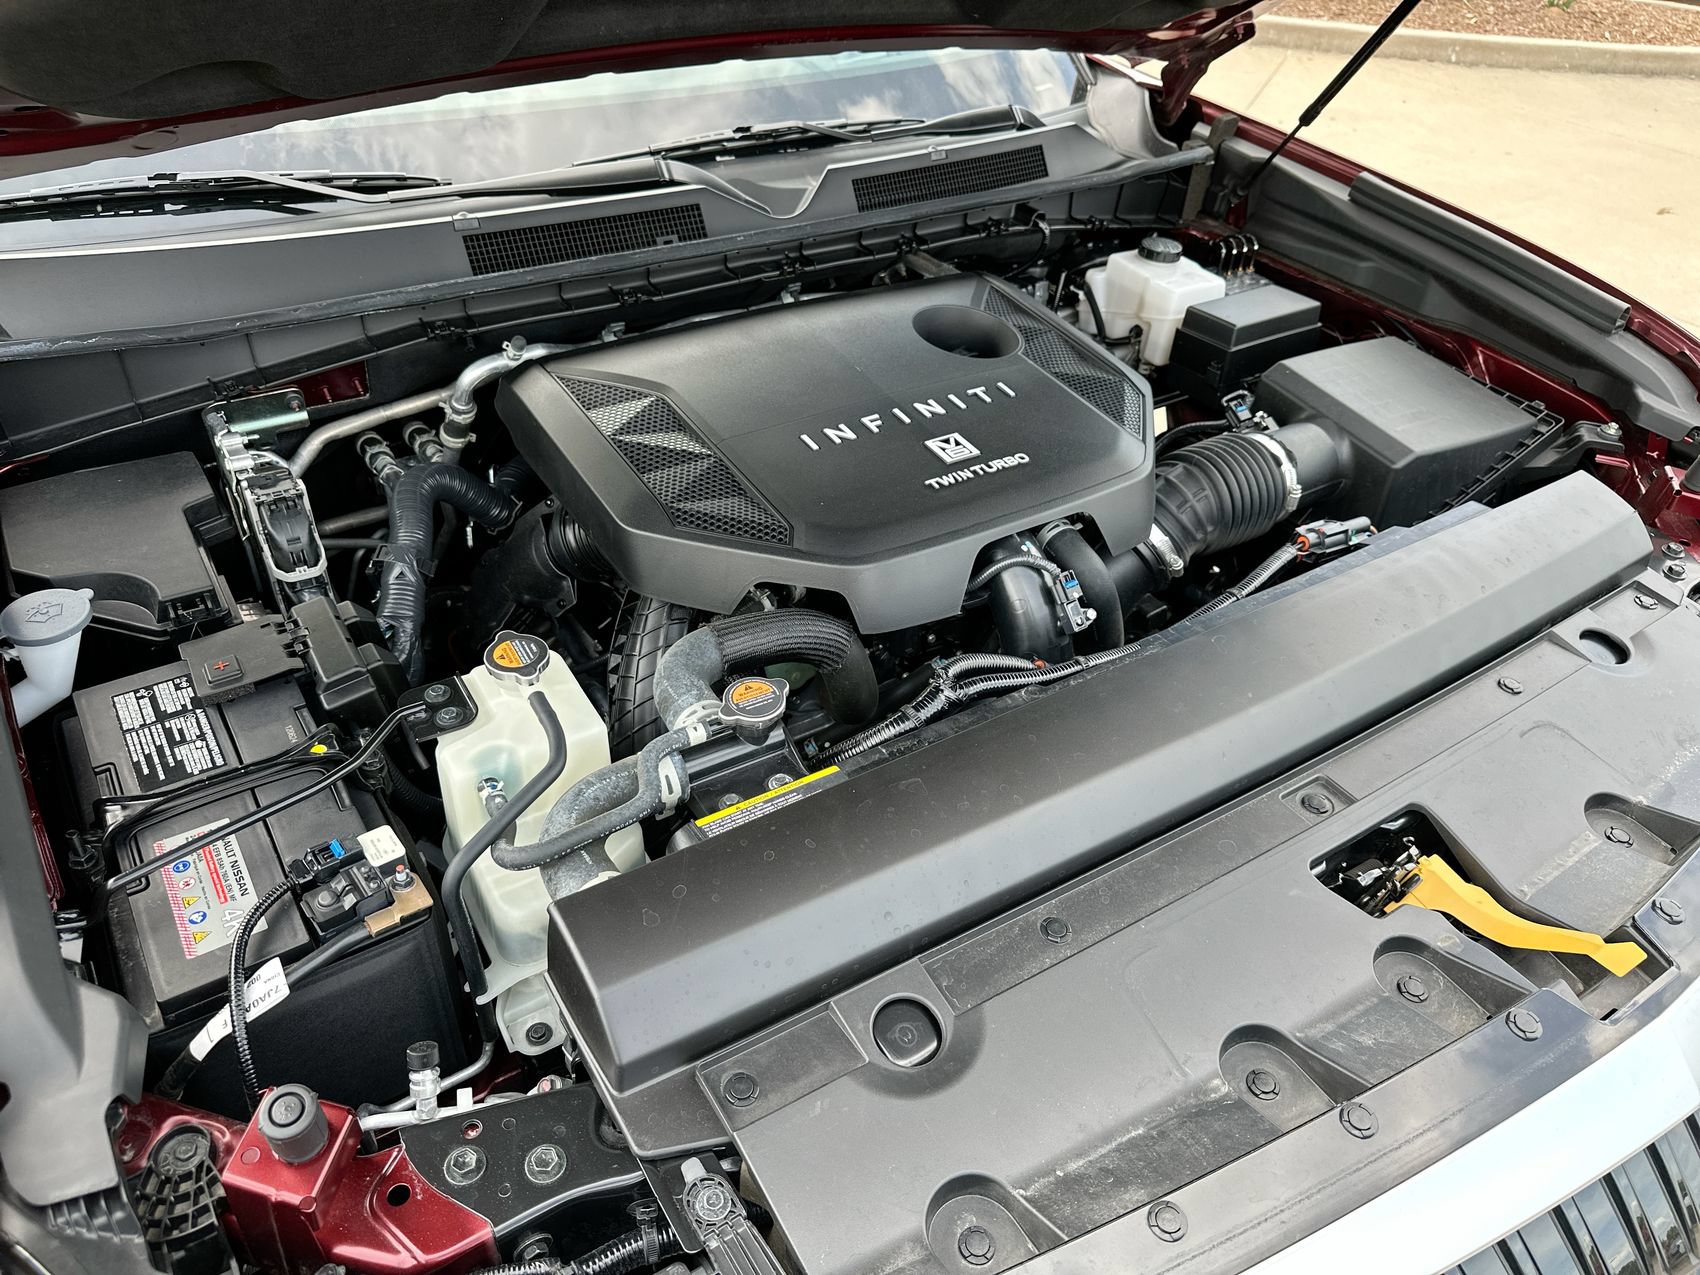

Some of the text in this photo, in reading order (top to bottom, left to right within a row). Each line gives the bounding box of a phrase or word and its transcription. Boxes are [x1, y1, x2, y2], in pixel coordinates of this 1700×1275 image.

[800, 382, 1016, 451] INFINITI
[743, 794, 768, 807] CAUTION
[774, 780, 804, 794] ATTENTION
[229, 859, 250, 897] NISSAN
